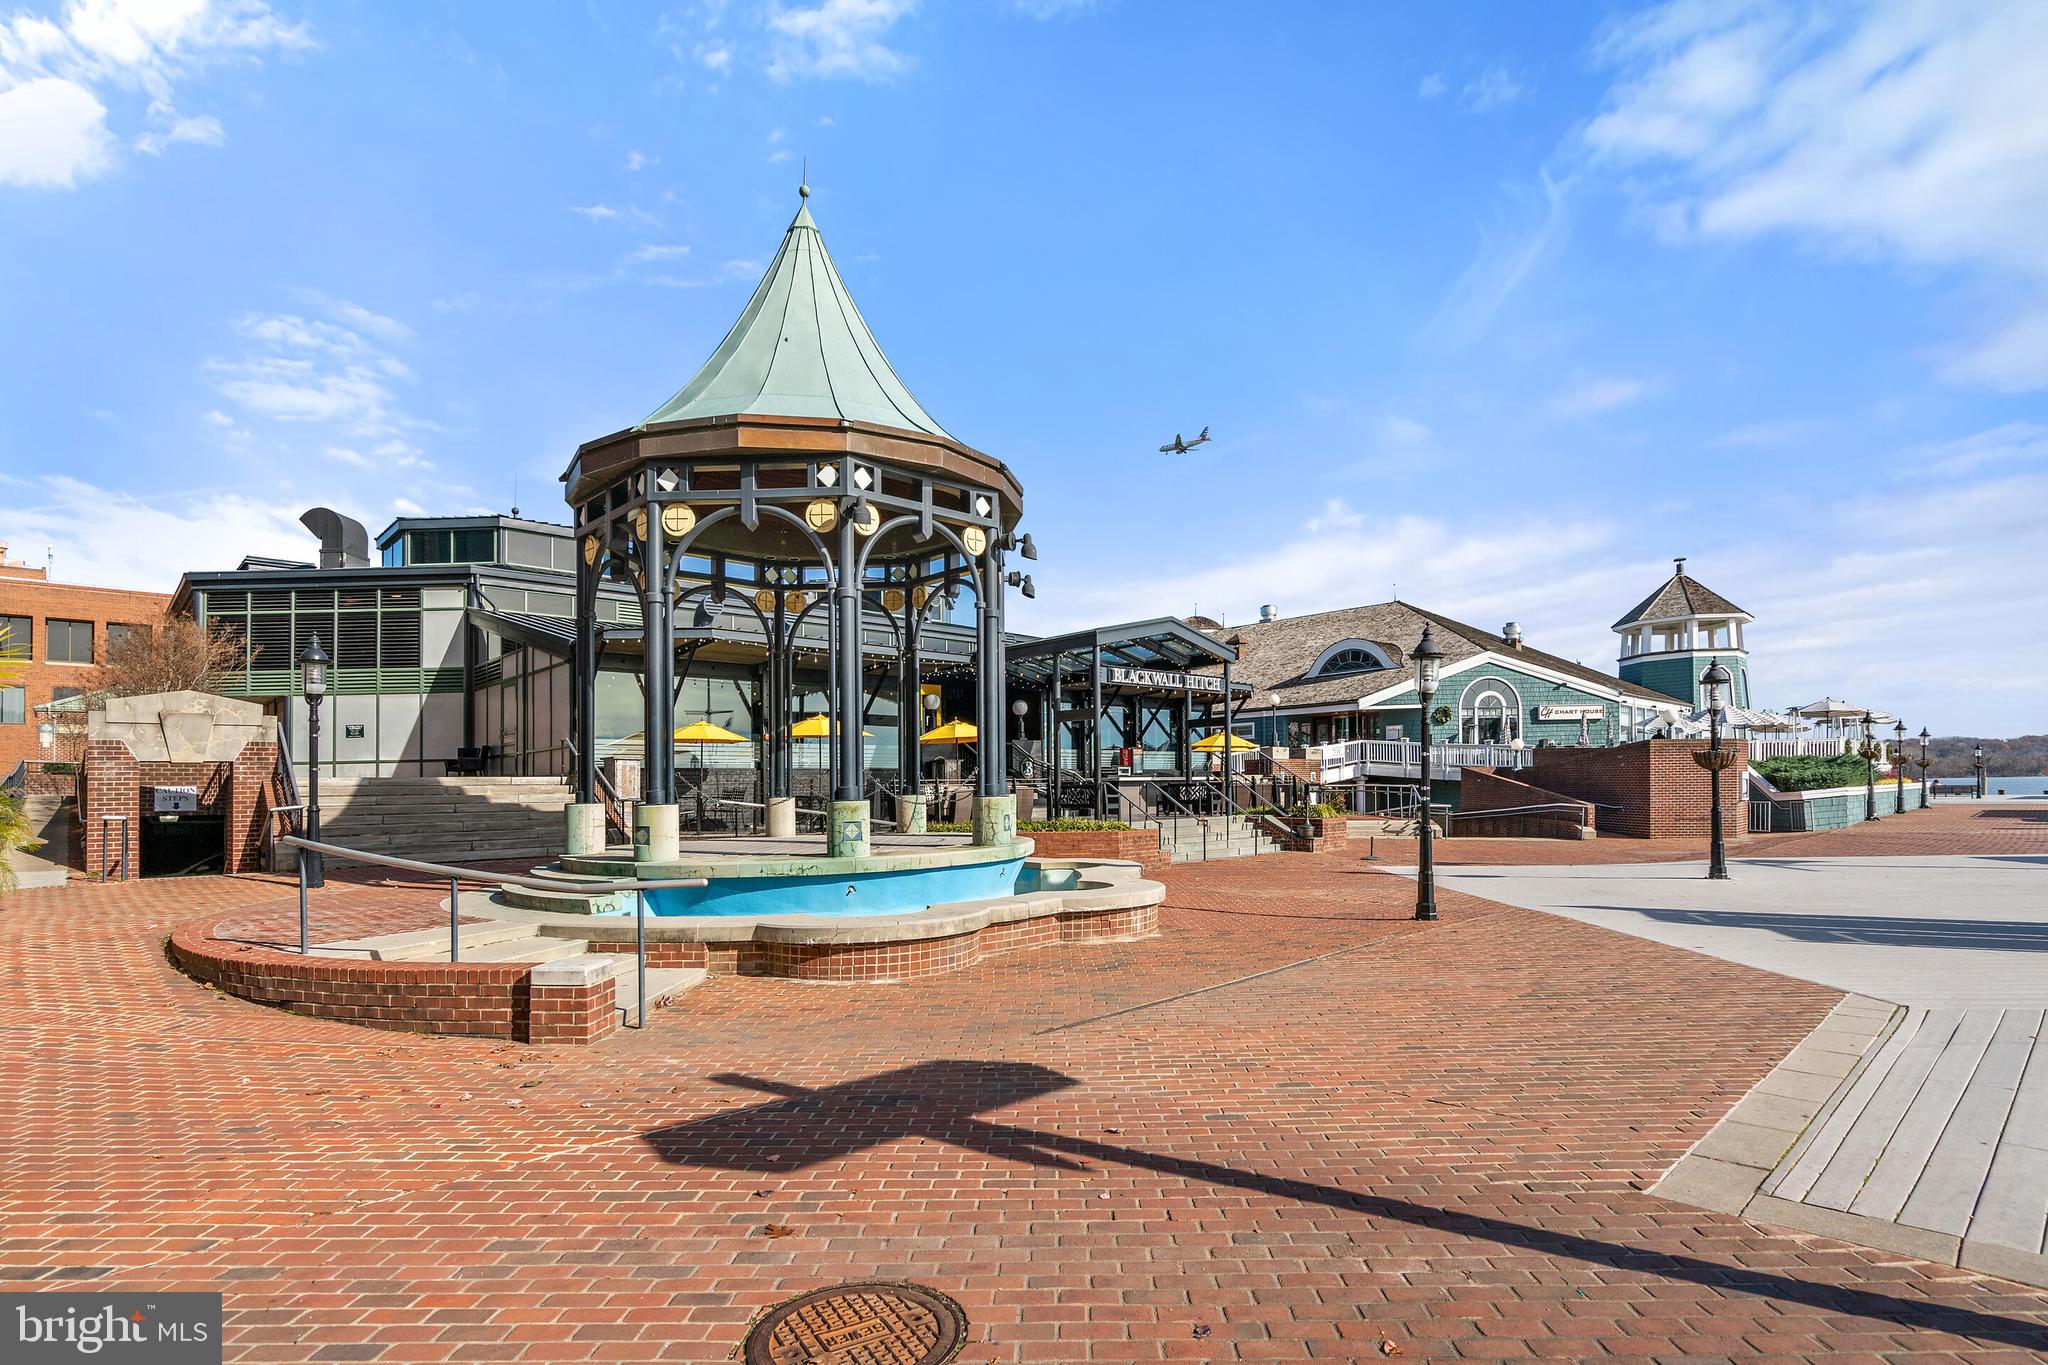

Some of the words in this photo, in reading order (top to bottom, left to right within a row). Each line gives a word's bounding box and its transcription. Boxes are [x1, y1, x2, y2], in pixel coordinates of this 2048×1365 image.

[1112, 667, 1183, 688] BLACKWALL
[1183, 674, 1222, 691] HITCH
[824, 1323, 886, 1346] SEWER
